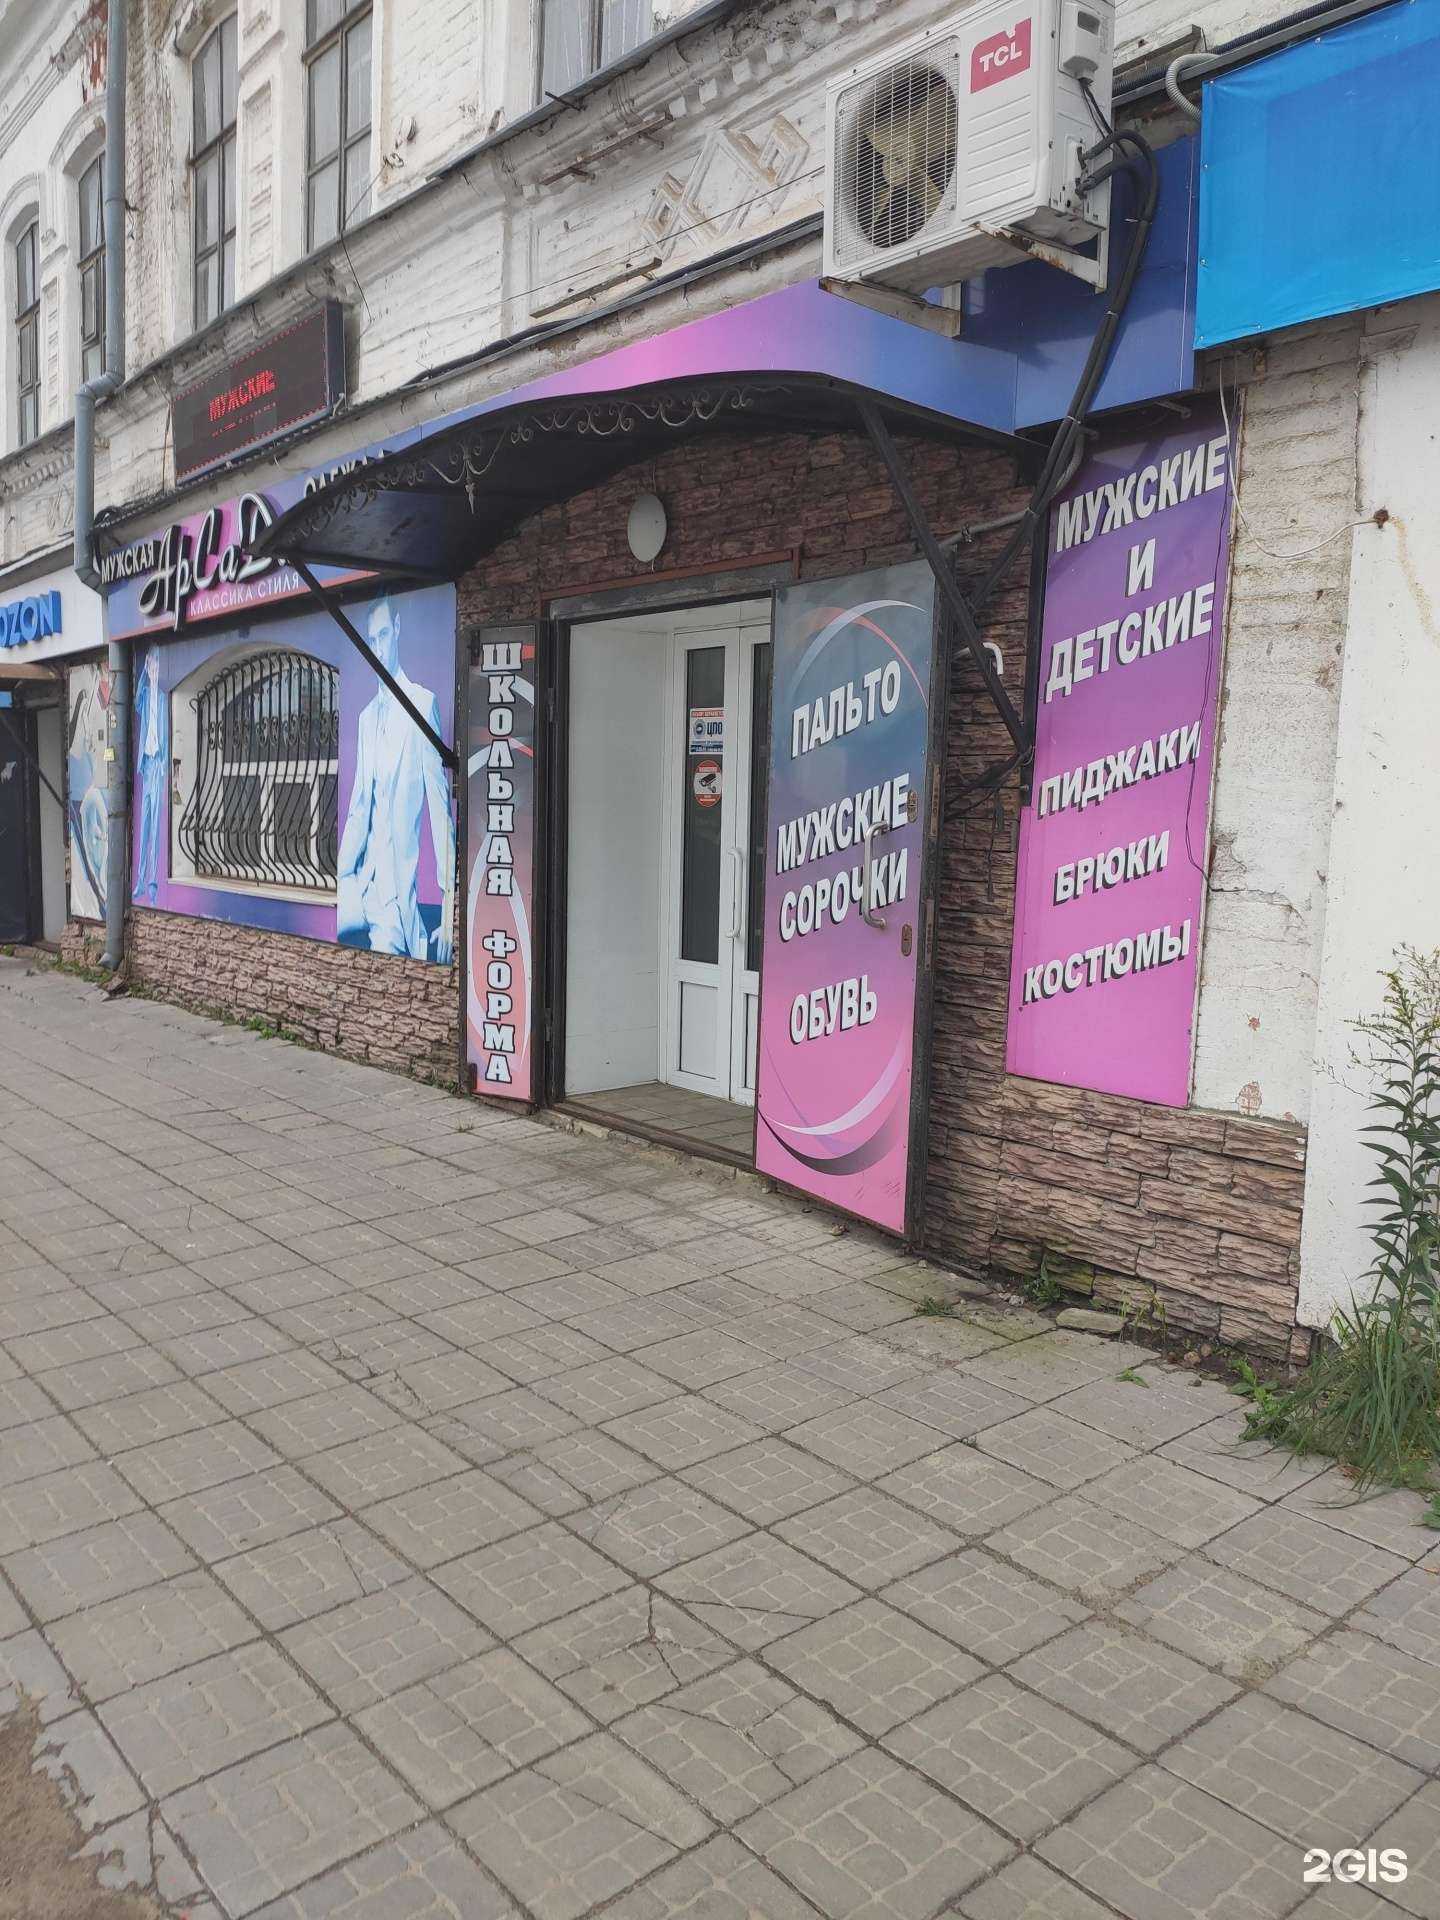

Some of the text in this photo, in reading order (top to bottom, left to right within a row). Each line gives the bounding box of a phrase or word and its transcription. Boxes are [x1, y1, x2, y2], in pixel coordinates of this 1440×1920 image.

[979, 41, 1022, 73] TCL
[1055, 434, 1229, 553] МУЖСКИЕ
[101, 543, 155, 584] МУЖСКАЯ
[190, 571, 300, 616] КЛАССИКА СТИЛЯ
[1126, 538, 1157, 598] И
[1045, 582, 1215, 702] ДЕТСКИЕ
[791, 660, 902, 758] ПАЛЬТО
[480, 642, 524, 897] ШКОЛЬНАЯ
[1038, 720, 1202, 817] ПИДЖАКИ
[776, 772, 911, 873] МУЖСКИЕ
[1054, 830, 1170, 904] БРЮКИ
[779, 847, 908, 942] СОРОЧКИ
[482, 928, 518, 1085] ФОРМА
[790, 974, 878, 1044] ОБУВЬ
[1023, 919, 1191, 1005] КОСТЮМЫ
